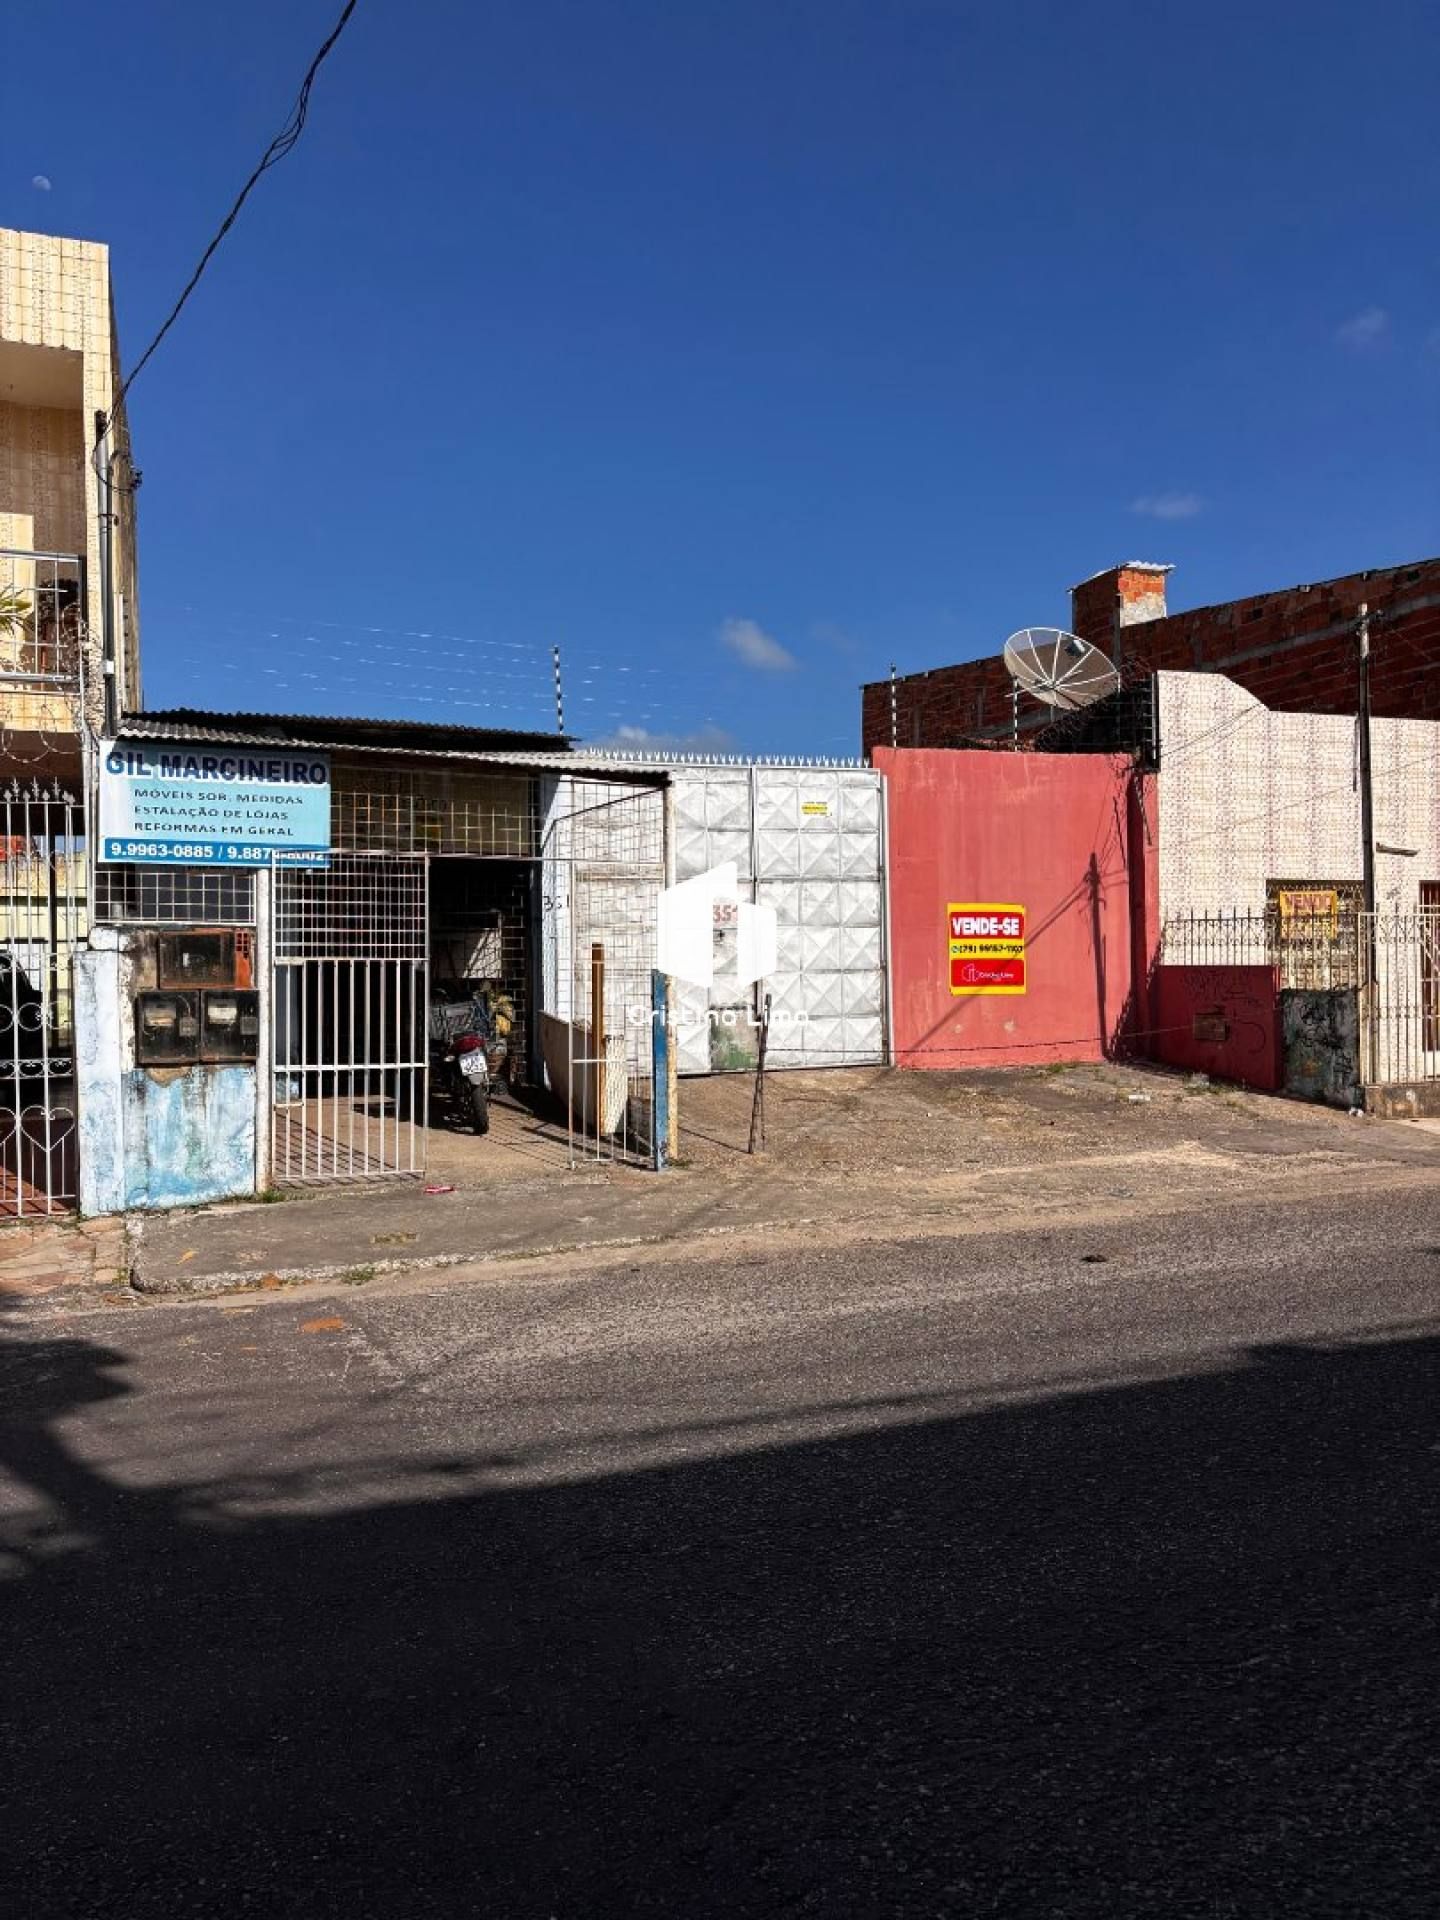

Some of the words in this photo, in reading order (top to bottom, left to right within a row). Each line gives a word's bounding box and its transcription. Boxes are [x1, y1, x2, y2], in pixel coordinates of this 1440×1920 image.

[106, 751, 152, 776] GIL
[161, 754, 327, 785] MARCINEIRO
[236, 794, 303, 805] MEDIDAS
[134, 805, 219, 818] ESTALAÇÃO
[223, 810, 242, 819] DE
[246, 810, 289, 820] LOJAS
[134, 822, 216, 833] REFORMAS
[221, 826, 243, 835] EM
[248, 827, 294, 836] GERAL
[111, 842, 214, 858] 9.9963-0885
[952, 916, 1020, 936] VENDE-SE
